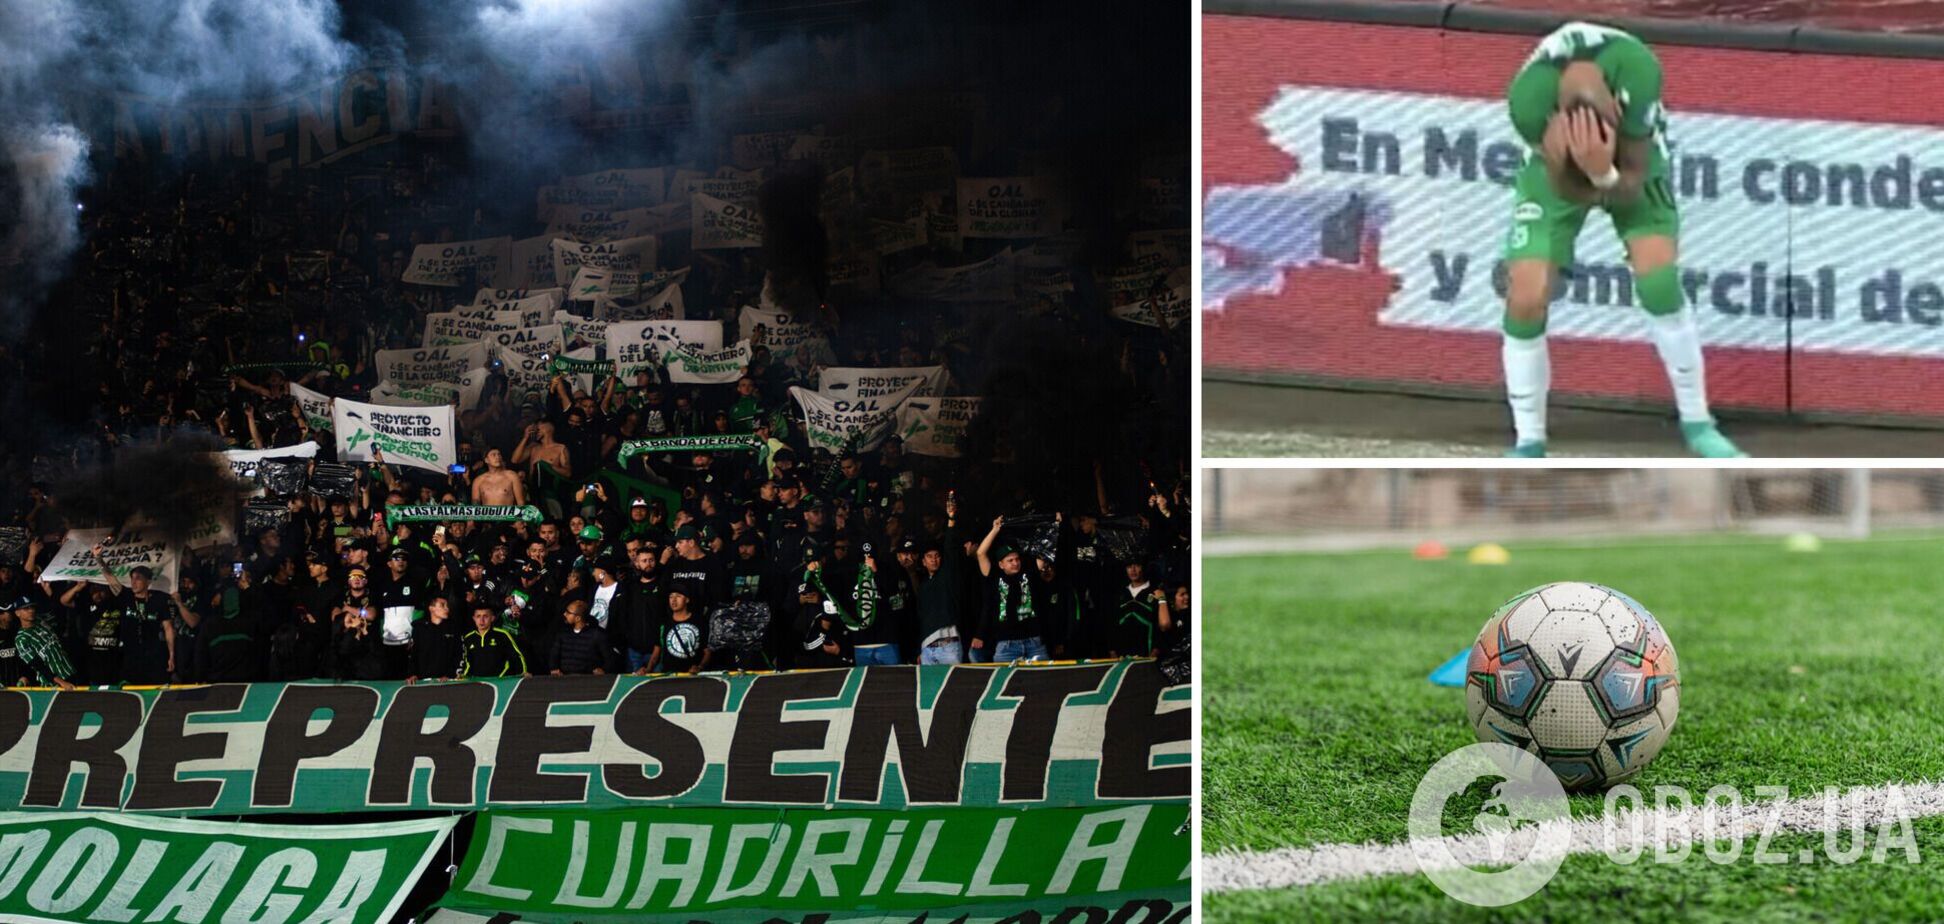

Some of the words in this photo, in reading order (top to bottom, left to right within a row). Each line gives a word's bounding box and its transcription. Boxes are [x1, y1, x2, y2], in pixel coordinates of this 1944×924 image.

[1321, 116, 1400, 176] En
[1742, 153, 1944, 212] conde
[988, 184, 1025, 199] OAL
[722, 205, 759, 222] OAL
[442, 245, 478, 259] OAL
[579, 244, 618, 254] OAL
[495, 288, 529, 301] OAL
[1429, 249, 1469, 303] y
[1860, 268, 1944, 326] de
[449, 328, 465, 339] LA
[497, 329, 538, 347] OAL
[412, 348, 452, 363] OAL
[619, 353, 635, 363] DE
[390, 371, 404, 380] DE
[406, 372, 420, 381] LA
[834, 400, 880, 413] OAL
[369, 411, 432, 426] PROYECTO
[633, 439, 648, 449] LA
[650, 438, 695, 448] BANDA
[699, 437, 716, 446] DE
[718, 434, 752, 446] RENE
[409, 505, 431, 517] LAS
[431, 505, 473, 517] PALMAS
[100, 542, 167, 558] CANSARON
[68, 558, 85, 567] DE
[106, 552, 152, 567] GLORIA
